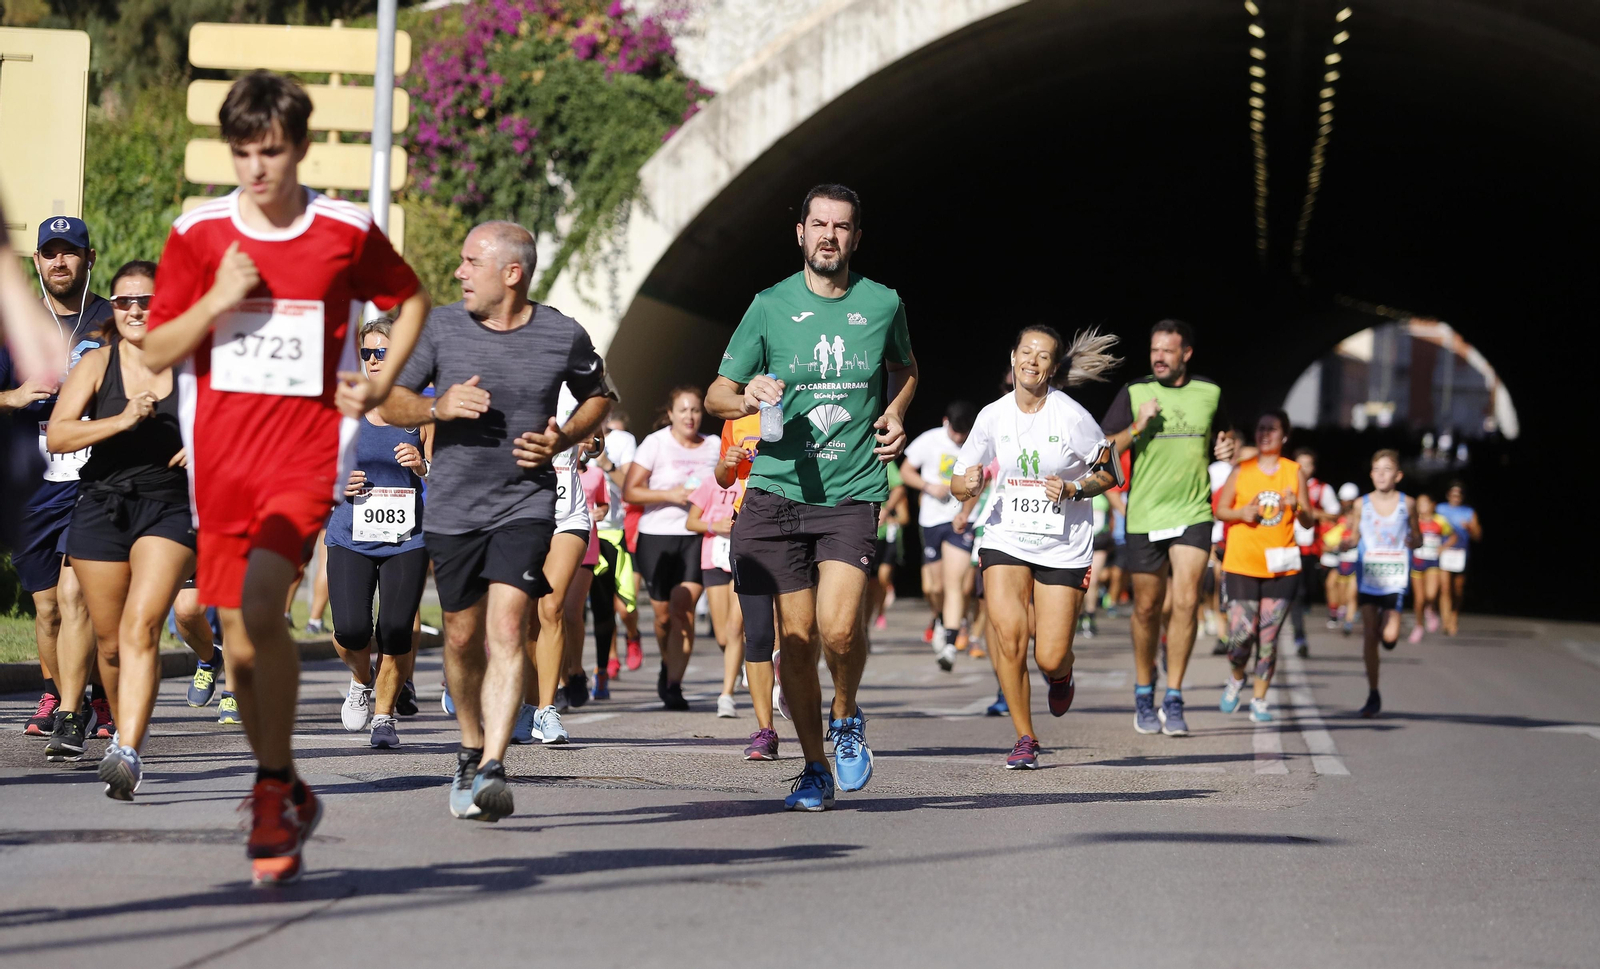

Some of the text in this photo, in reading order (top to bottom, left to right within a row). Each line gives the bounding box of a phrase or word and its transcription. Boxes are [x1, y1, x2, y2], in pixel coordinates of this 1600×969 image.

[233, 333, 302, 360] 3723
[807, 382, 841, 390] CARRERA
[807, 450, 838, 461] Unicaja
[720, 490, 738, 505] 77
[364, 508, 406, 524] 9083
